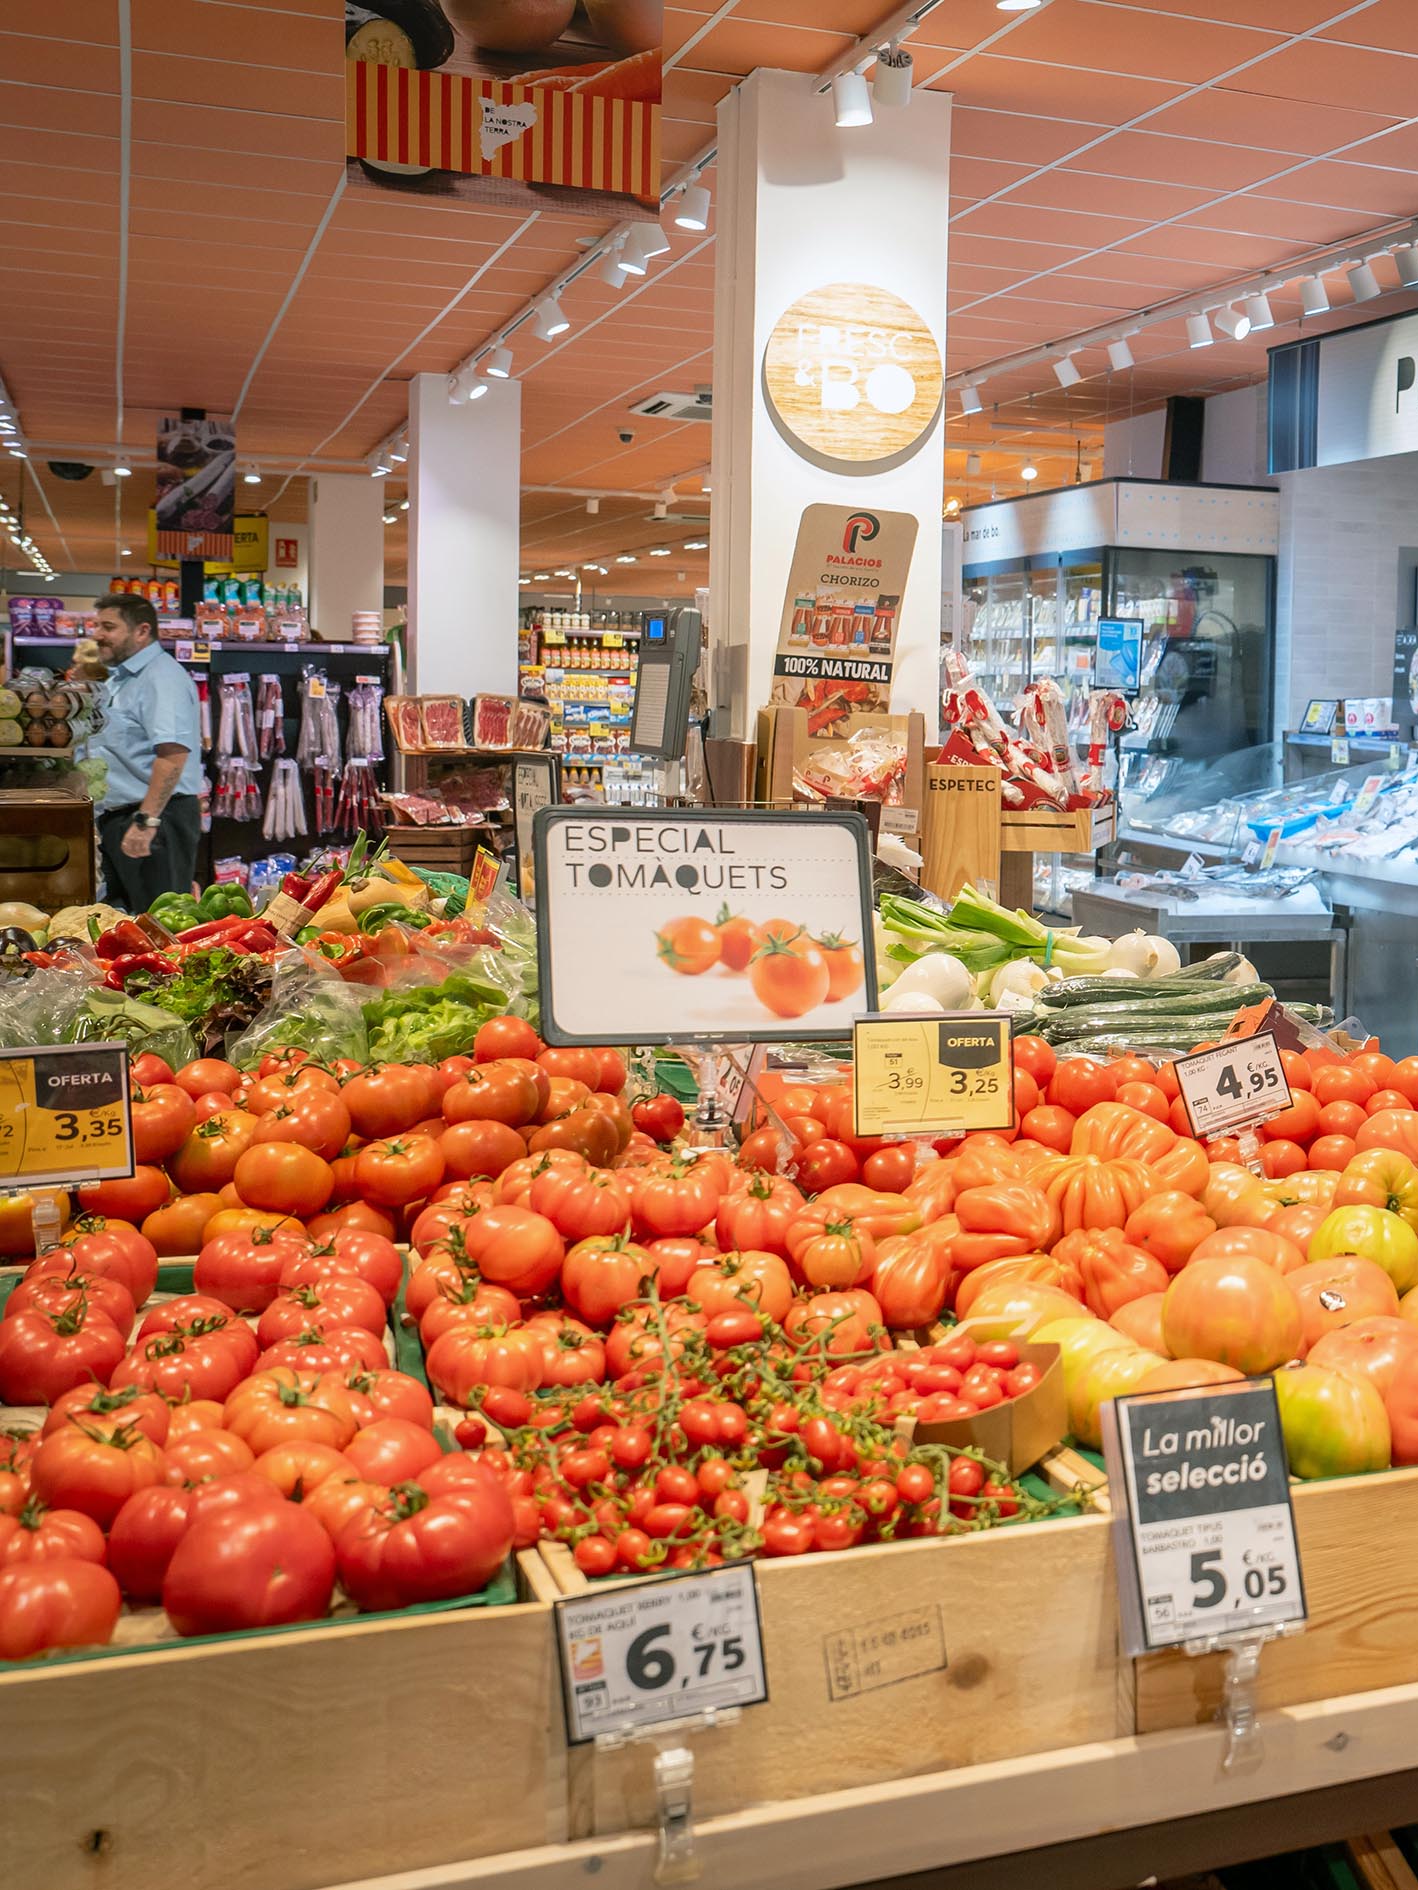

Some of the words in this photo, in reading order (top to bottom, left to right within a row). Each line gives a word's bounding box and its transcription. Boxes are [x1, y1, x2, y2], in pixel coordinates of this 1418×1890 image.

[485, 106, 495, 114] DE
[485, 126, 510, 135] TERRA
[496, 118, 527, 128] NOSTRA
[798, 323, 913, 360] FRESC
[821, 359, 916, 414] BO
[234, 532, 259, 544] ERTA
[826, 554, 882, 569] PALACIOS
[821, 573, 880, 588] CHORIZO
[784, 657, 819, 675] 100%
[821, 659, 889, 681] NATURAL
[929, 778, 996, 792] ESPETEC
[565, 826, 736, 854] ESPECIAL
[565, 857, 788, 895] TOMÀQUETS
[947, 1037, 995, 1048] OFERTA
[48, 1072, 113, 1087] OFERTA
[888, 1072, 924, 1090] 3,99
[950, 1070, 999, 1097] 3,25
[1216, 1064, 1279, 1100] 4,95
[54, 1112, 123, 1142] 3,35
[1143, 1428, 1179, 1457] La
[1185, 1415, 1266, 1452] millor
[1145, 1451, 1268, 1495] selecció
[1190, 1549, 1287, 1609] 5,05
[626, 1622, 746, 1690] 6,75
